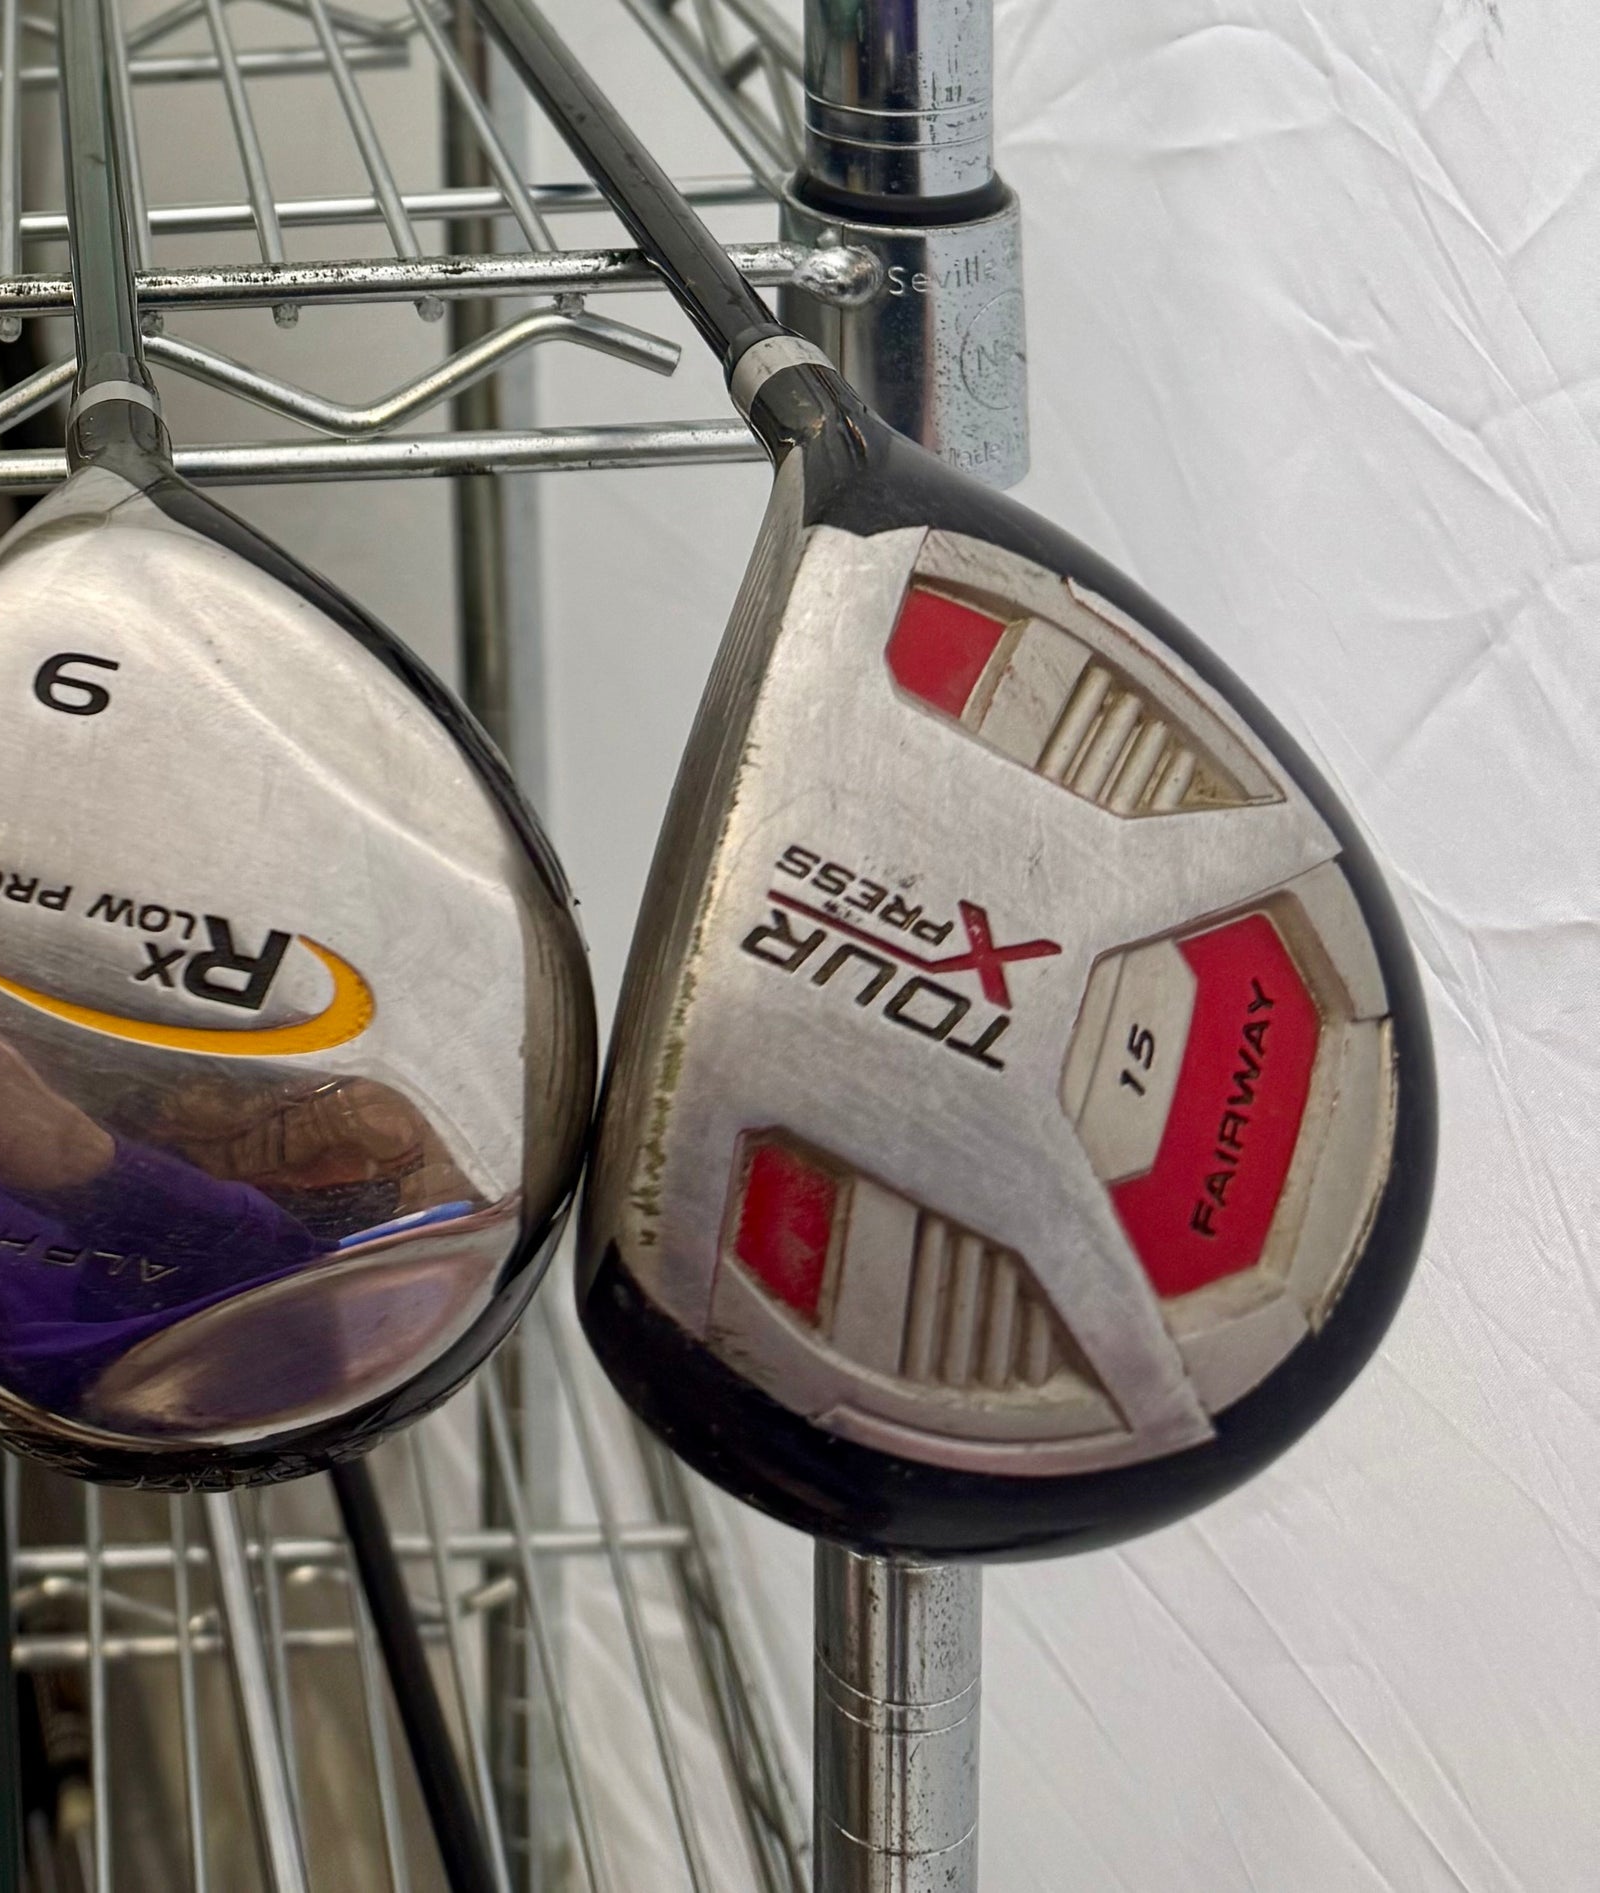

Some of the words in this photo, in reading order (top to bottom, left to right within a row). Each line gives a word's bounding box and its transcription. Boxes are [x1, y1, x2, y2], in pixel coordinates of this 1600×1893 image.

[31, 650, 121, 717] 9
[87, 888, 197, 941] LOW
[738, 905, 1012, 1072] TOUR
[1119, 1023, 1158, 1098] 15
[1189, 980, 1274, 1240] FAIRWAY
